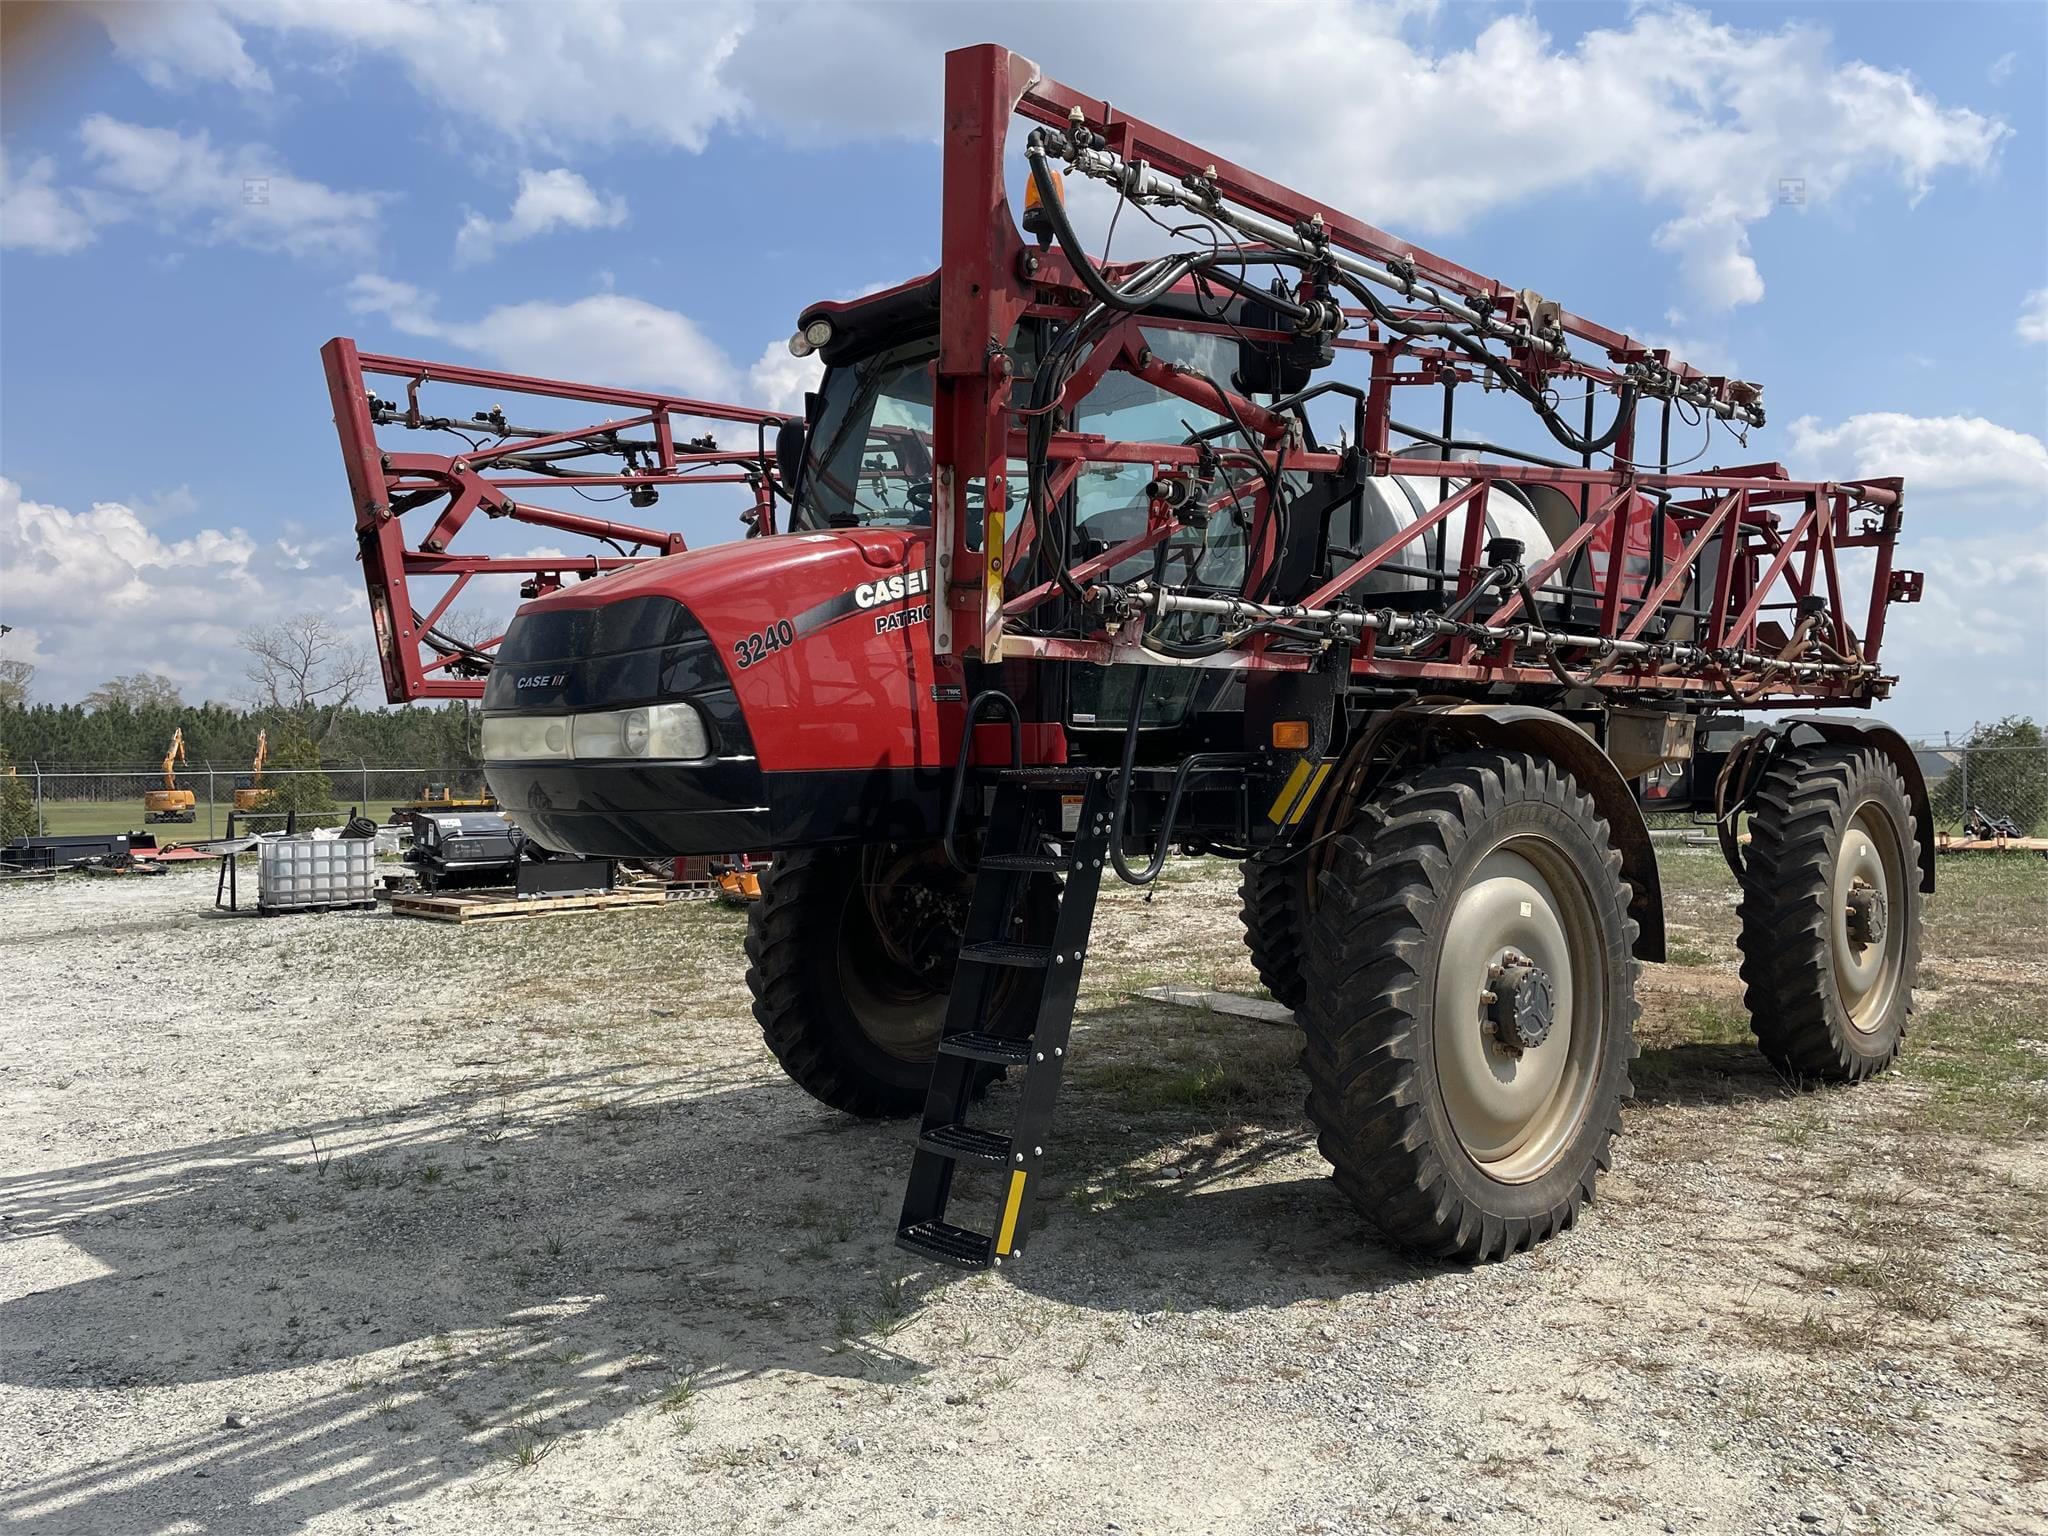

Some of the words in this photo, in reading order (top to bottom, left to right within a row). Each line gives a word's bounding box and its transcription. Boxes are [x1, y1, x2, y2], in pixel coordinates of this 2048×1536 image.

[875, 603, 933, 635] PATRIO
[734, 619, 793, 669] 3240
[517, 675, 550, 689] CASE
